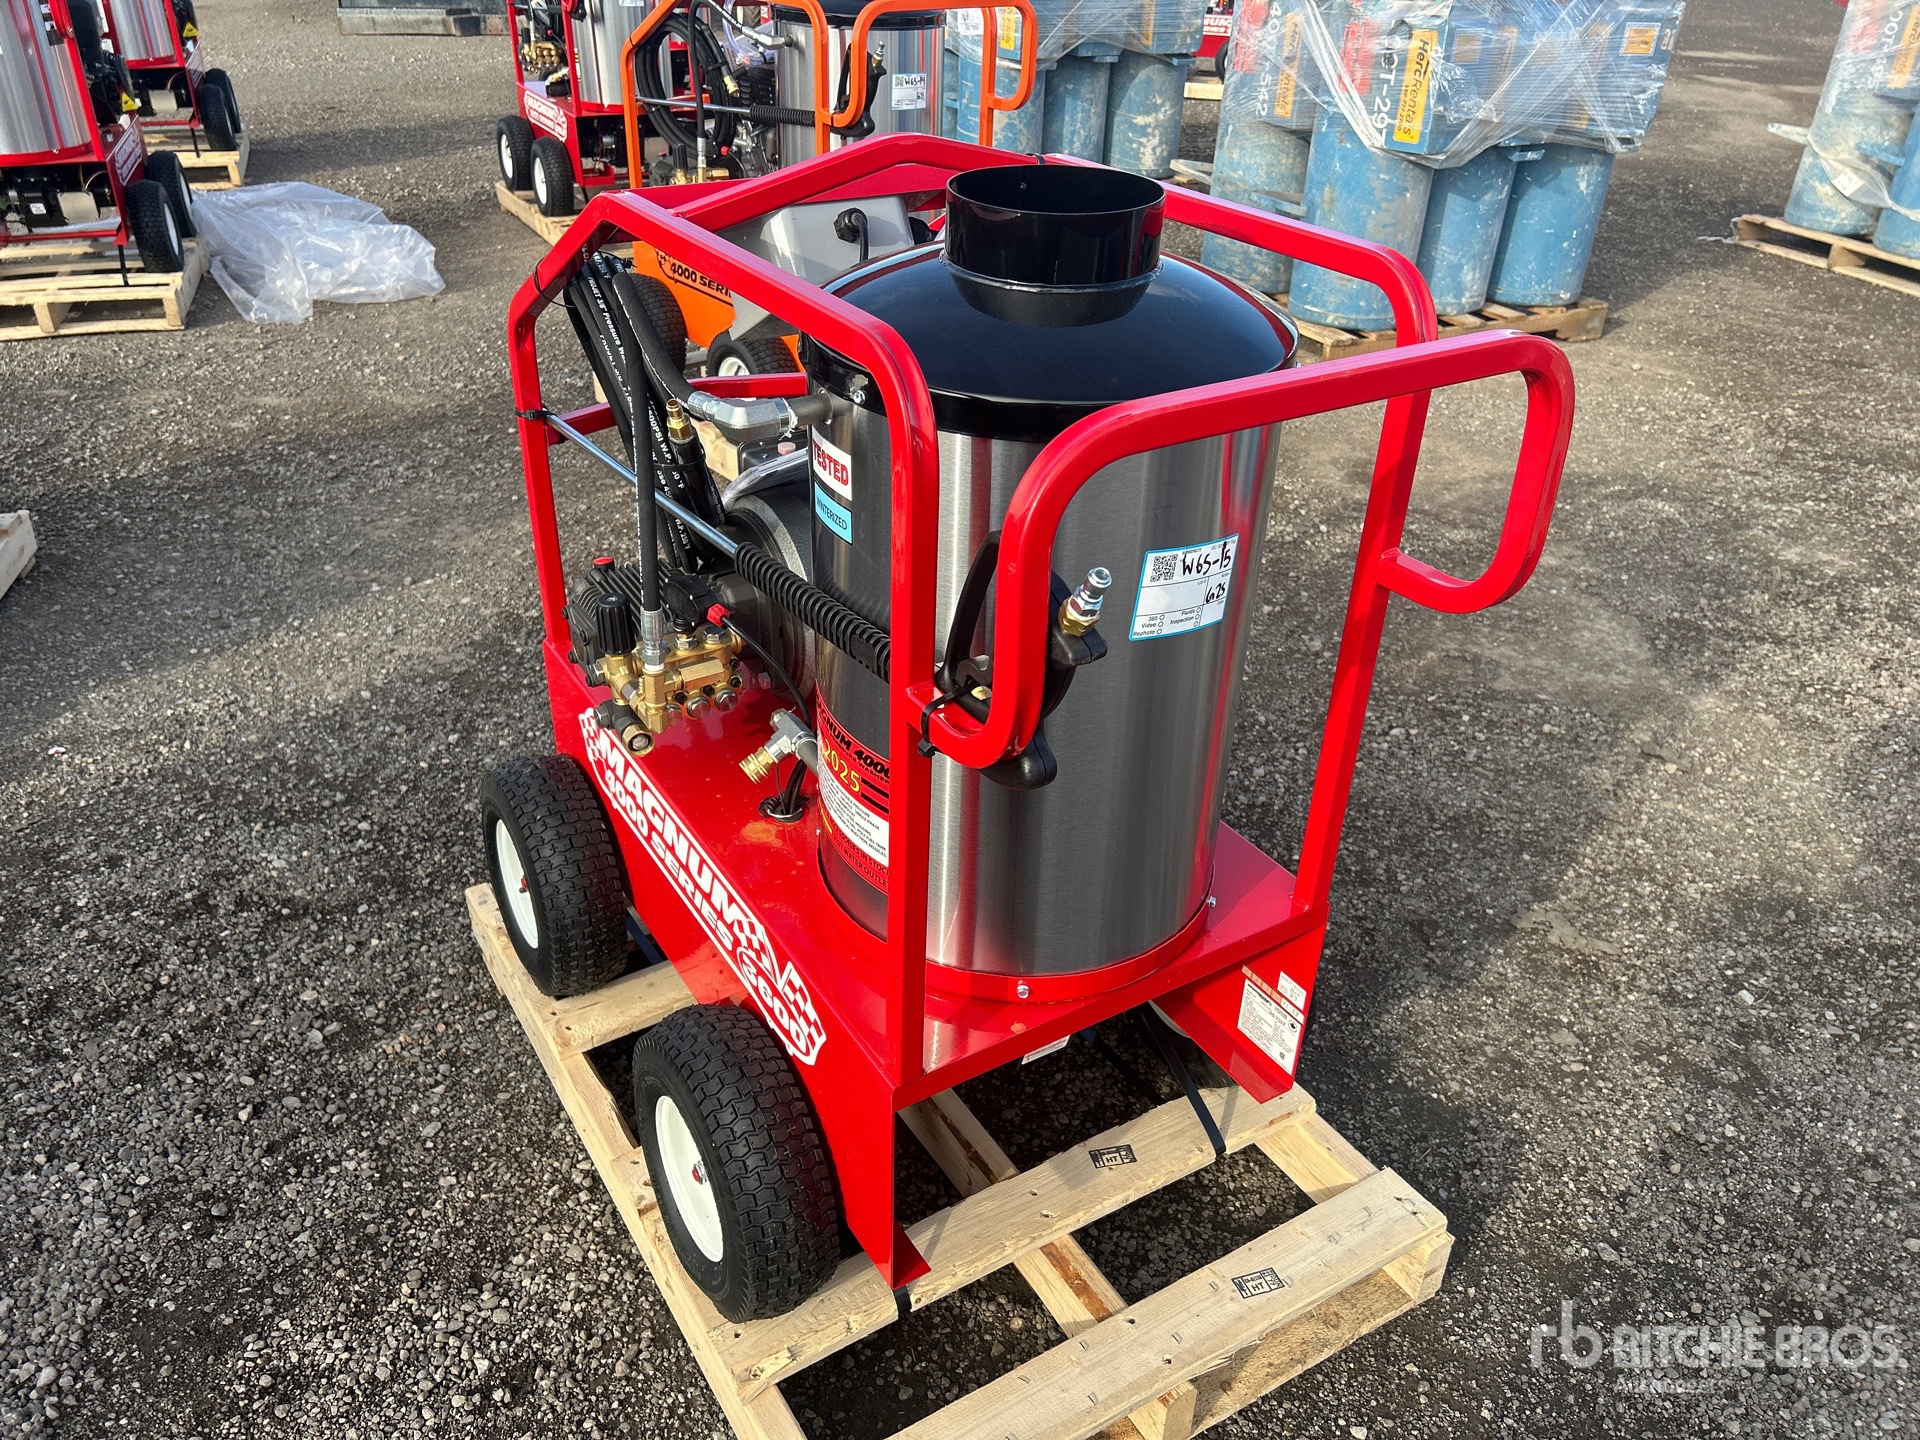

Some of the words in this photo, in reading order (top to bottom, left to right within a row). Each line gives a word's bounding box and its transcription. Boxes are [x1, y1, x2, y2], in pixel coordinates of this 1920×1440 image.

[670, 262, 697, 283] 4000
[603, 312, 621, 345] Pressure
[812, 439, 849, 486] TESTED
[822, 738, 860, 793] 2025
[599, 728, 750, 923] MAGNUM
[605, 769, 649, 838] 4000
[650, 831, 734, 951] SERIES
[863, 866, 889, 888] OUTLE
[743, 957, 807, 1052] 3600
[1105, 1155, 1118, 1163] HT
[1251, 1282, 1264, 1292] HT
